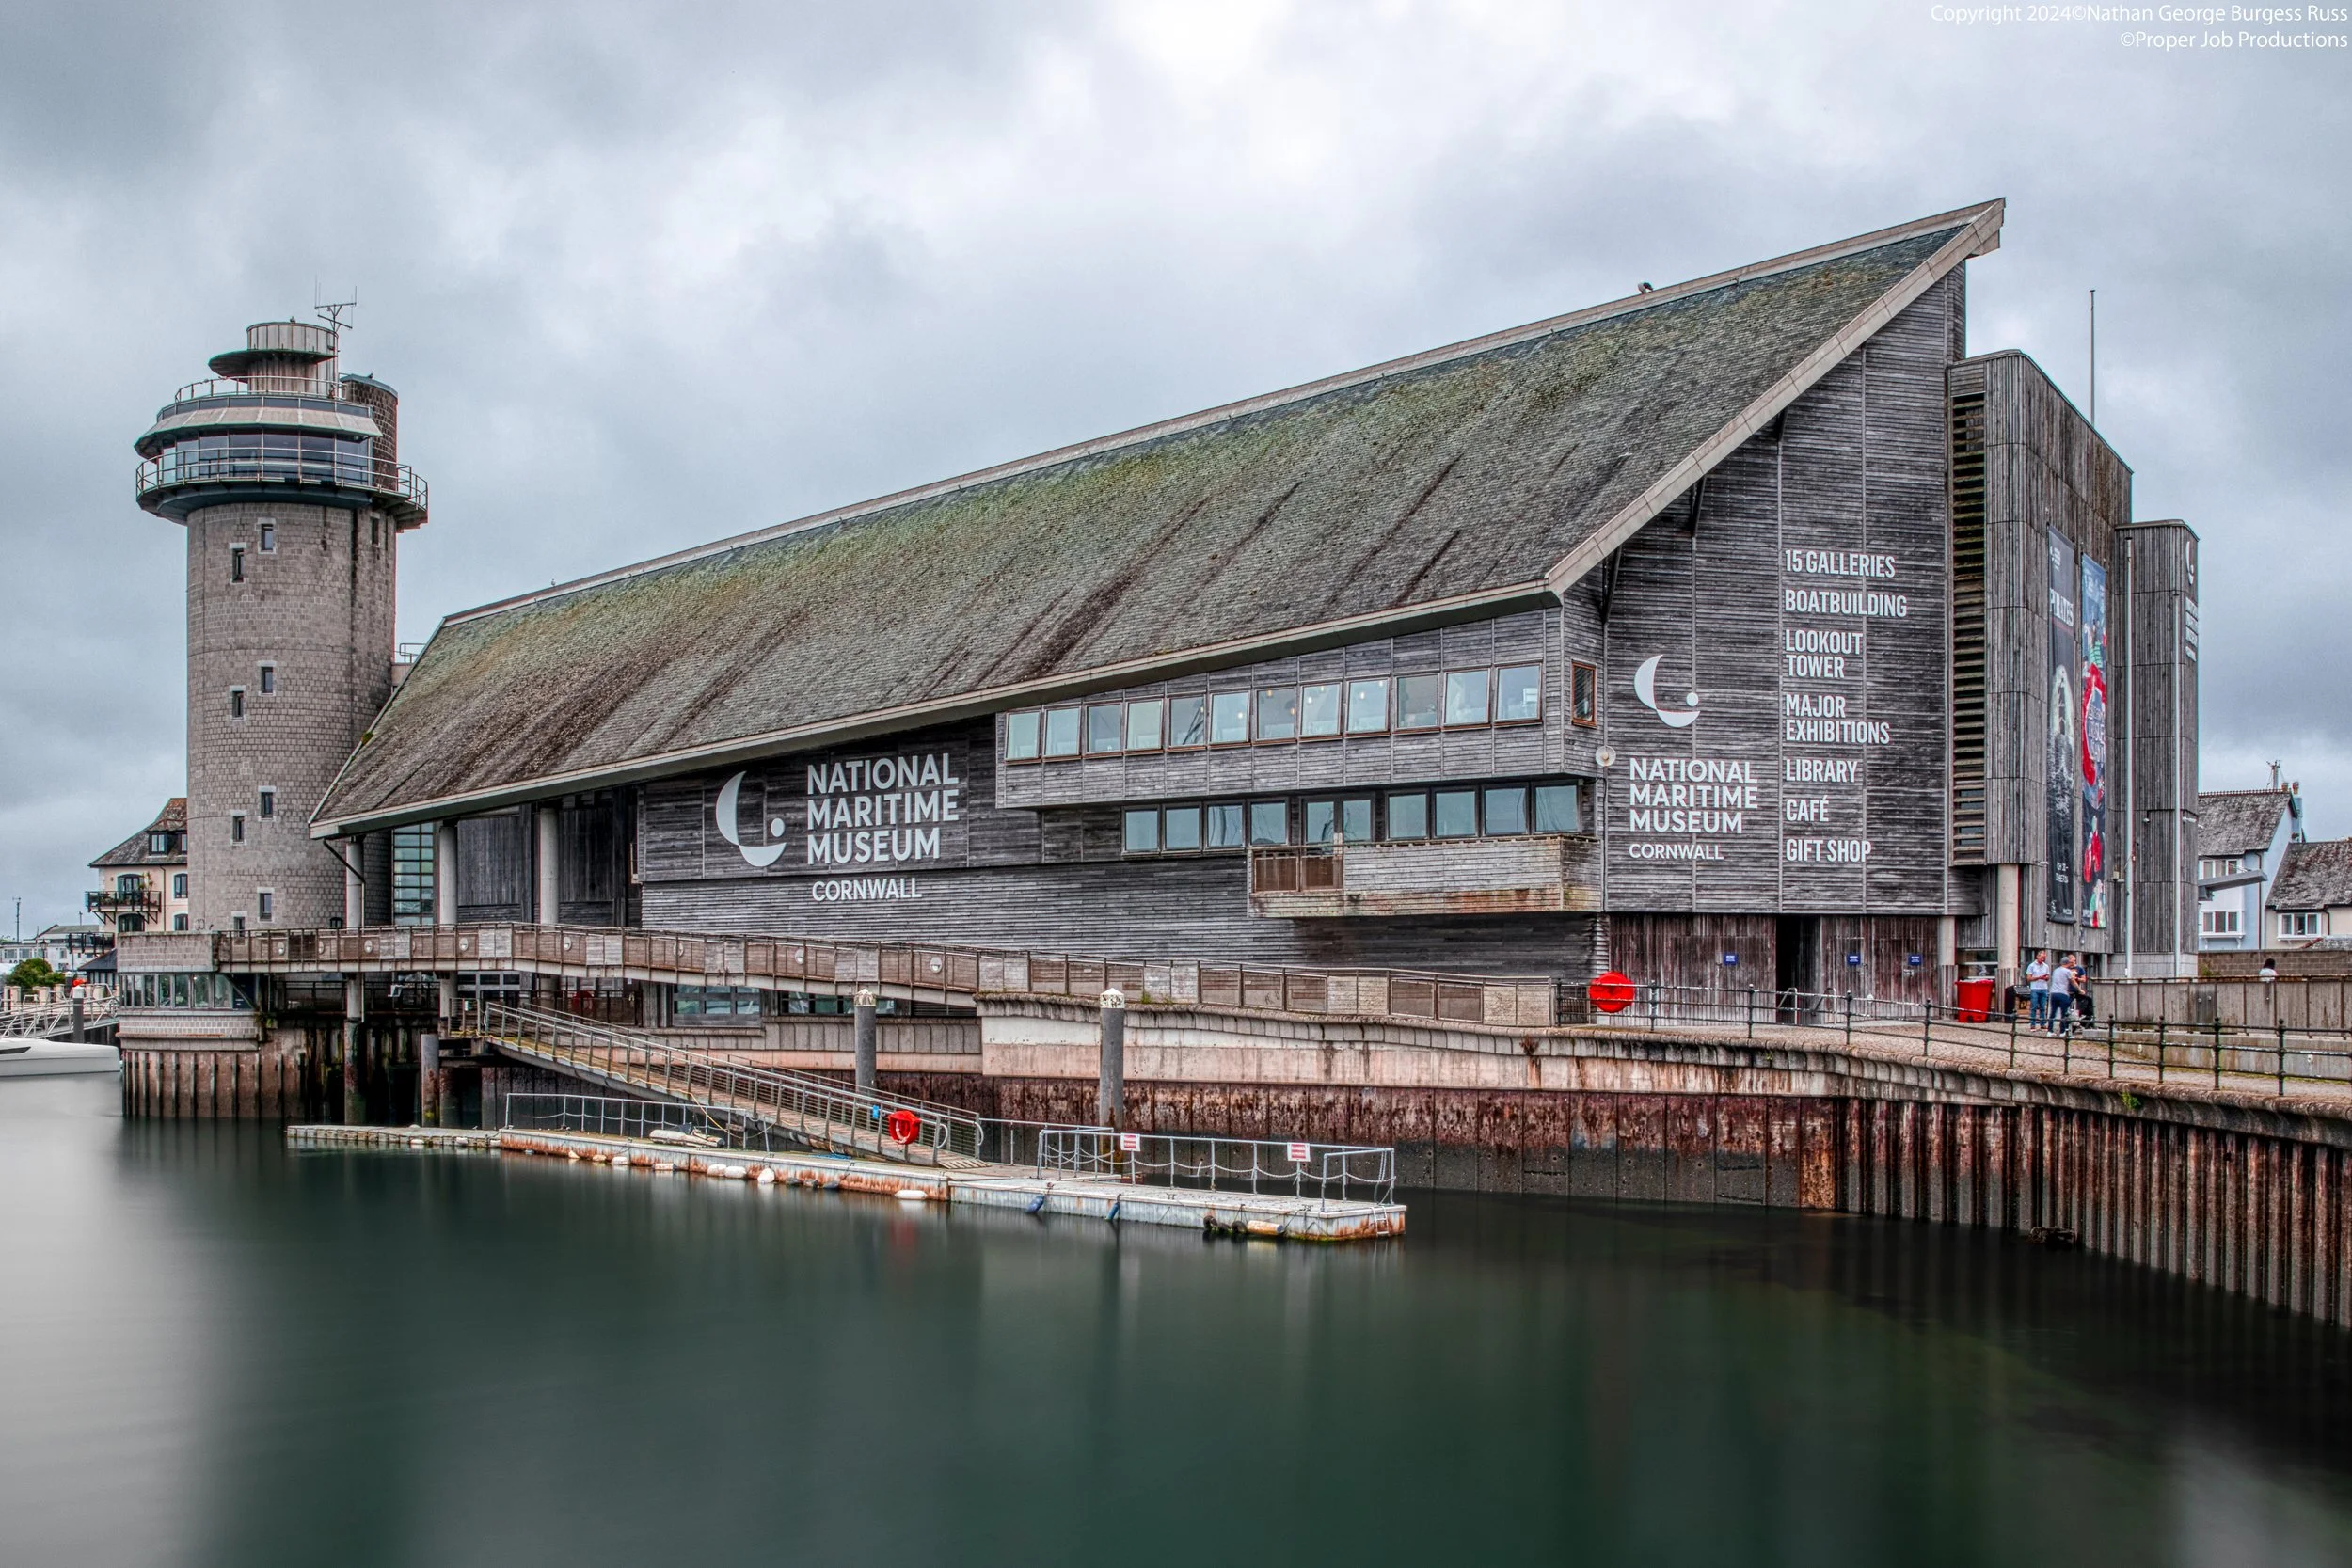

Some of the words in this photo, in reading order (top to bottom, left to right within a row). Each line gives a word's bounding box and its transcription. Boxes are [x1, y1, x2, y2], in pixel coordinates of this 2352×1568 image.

[1785, 549, 1803, 573] 15
[1805, 551, 1896, 578] GALLERIES
[1785, 590, 1907, 618] BOATBUILDING
[1786, 629, 1864, 655] LOOKOUT
[1786, 655, 1845, 679] TOWER
[1786, 694, 1846, 718] MAJOR
[1786, 720, 1890, 745] EXHIBITIONS
[807, 752, 959, 795] NATIONAL
[1629, 757, 1758, 784] NATIONAL
[1786, 759, 1859, 783] LIBRARY
[1629, 784, 1758, 809] MARITIME
[1786, 795, 1830, 822] CAFÉ
[807, 789, 960, 830] MARITIME
[1629, 810, 1742, 834] MUSEUM
[807, 827, 940, 865] MUSEUM
[1629, 844, 1724, 861] CORNWALL
[1786, 839, 1824, 862] GIFT
[1827, 840, 1872, 863] SHOP
[812, 878, 923, 902] CORNWALL
